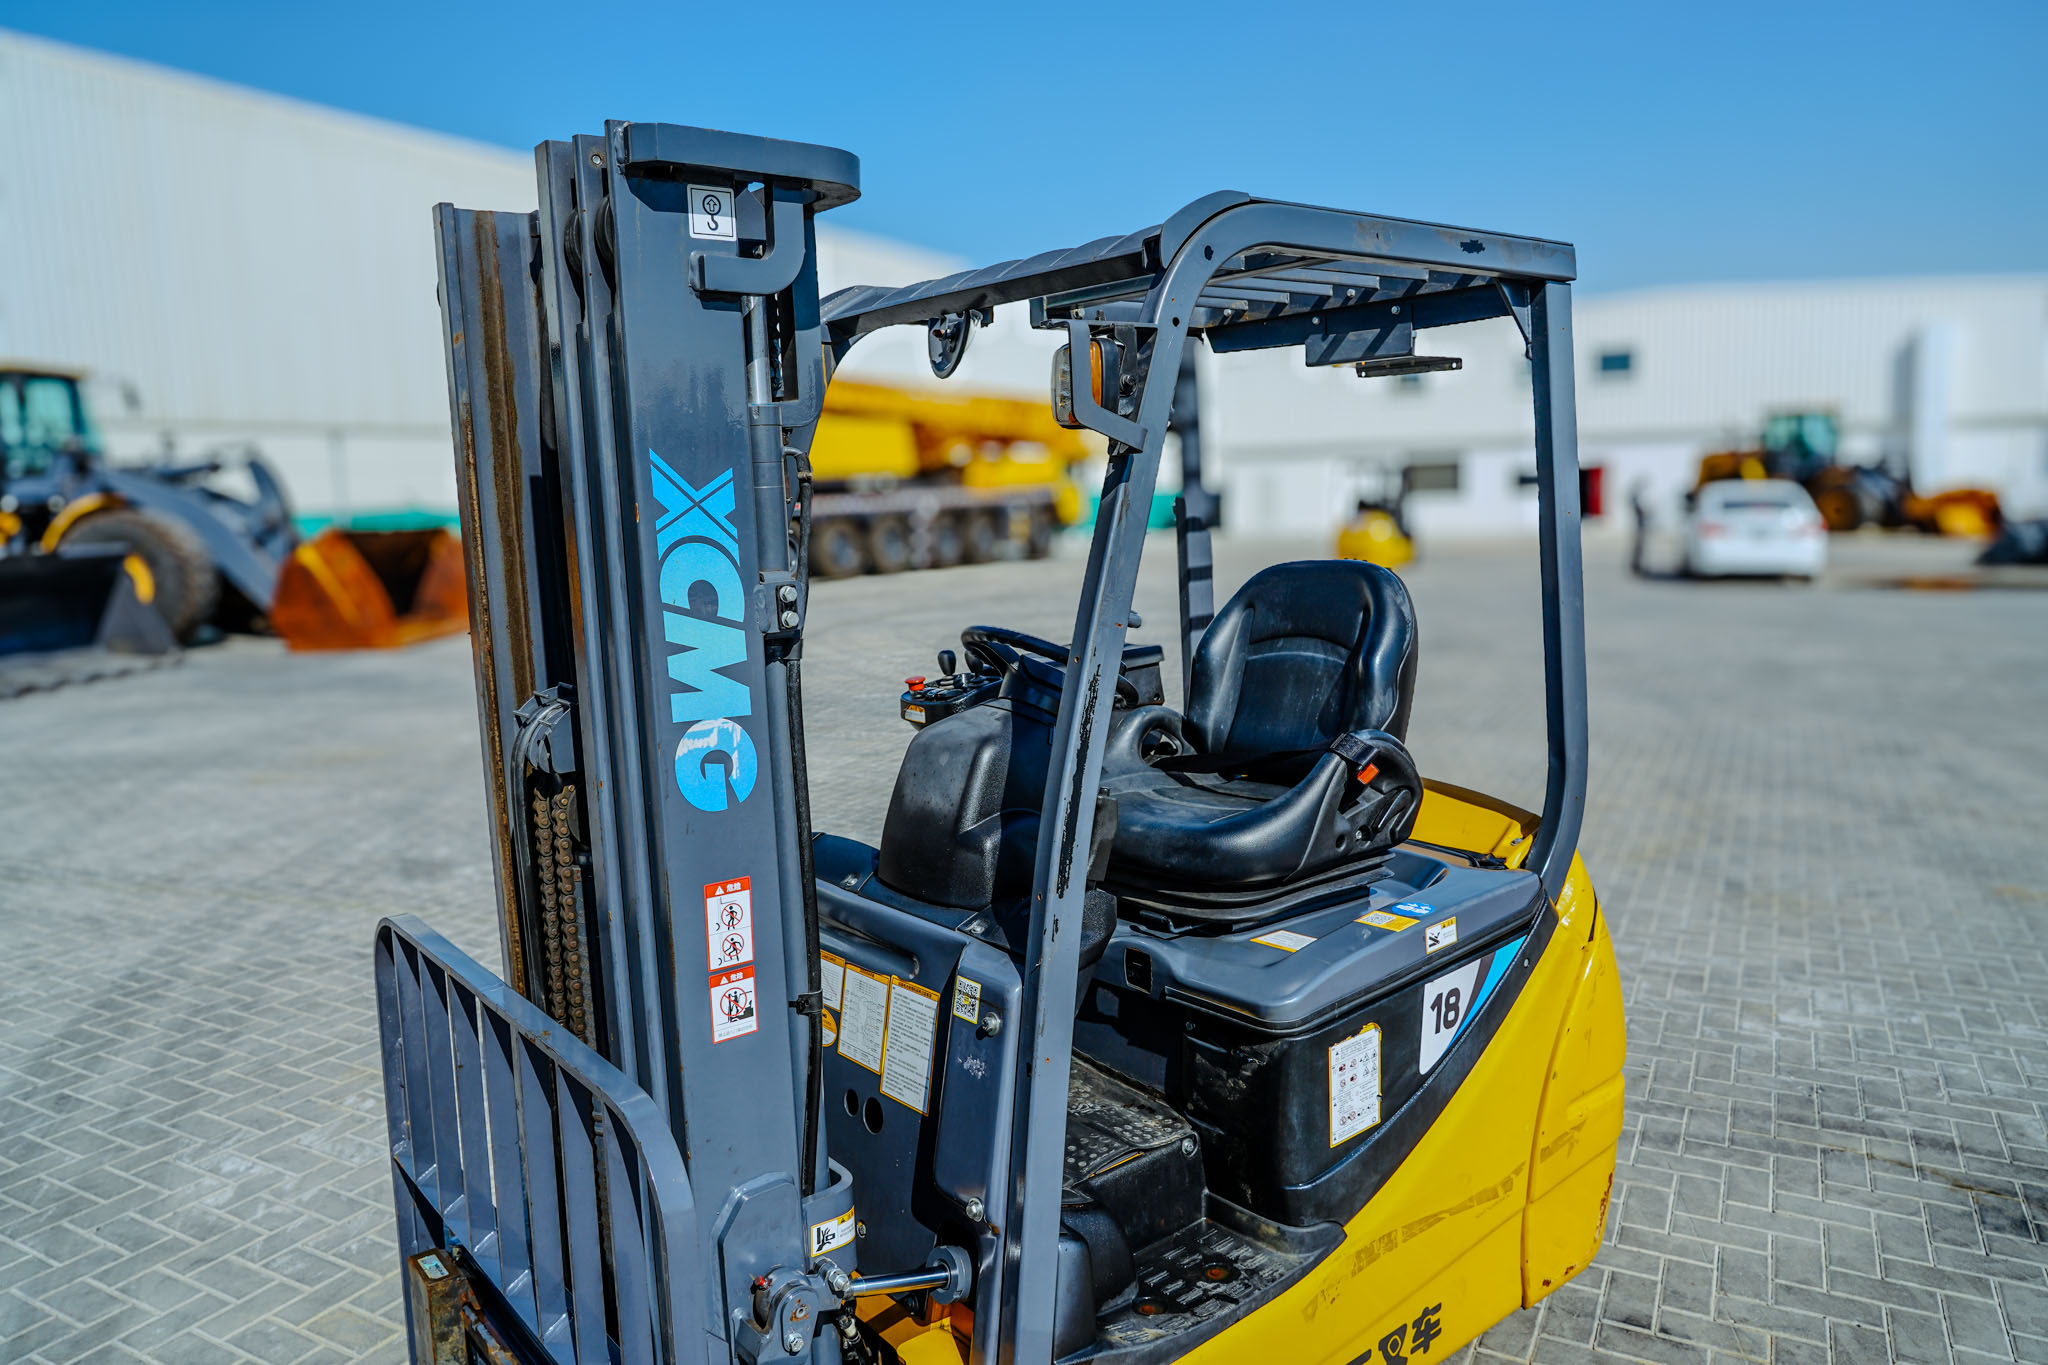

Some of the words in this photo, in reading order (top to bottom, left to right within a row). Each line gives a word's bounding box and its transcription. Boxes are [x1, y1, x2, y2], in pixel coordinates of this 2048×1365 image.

[649, 448, 758, 812] XCMG
[1430, 987, 1460, 1034] 18
[1346, 1302, 1442, 1365] 叉车
